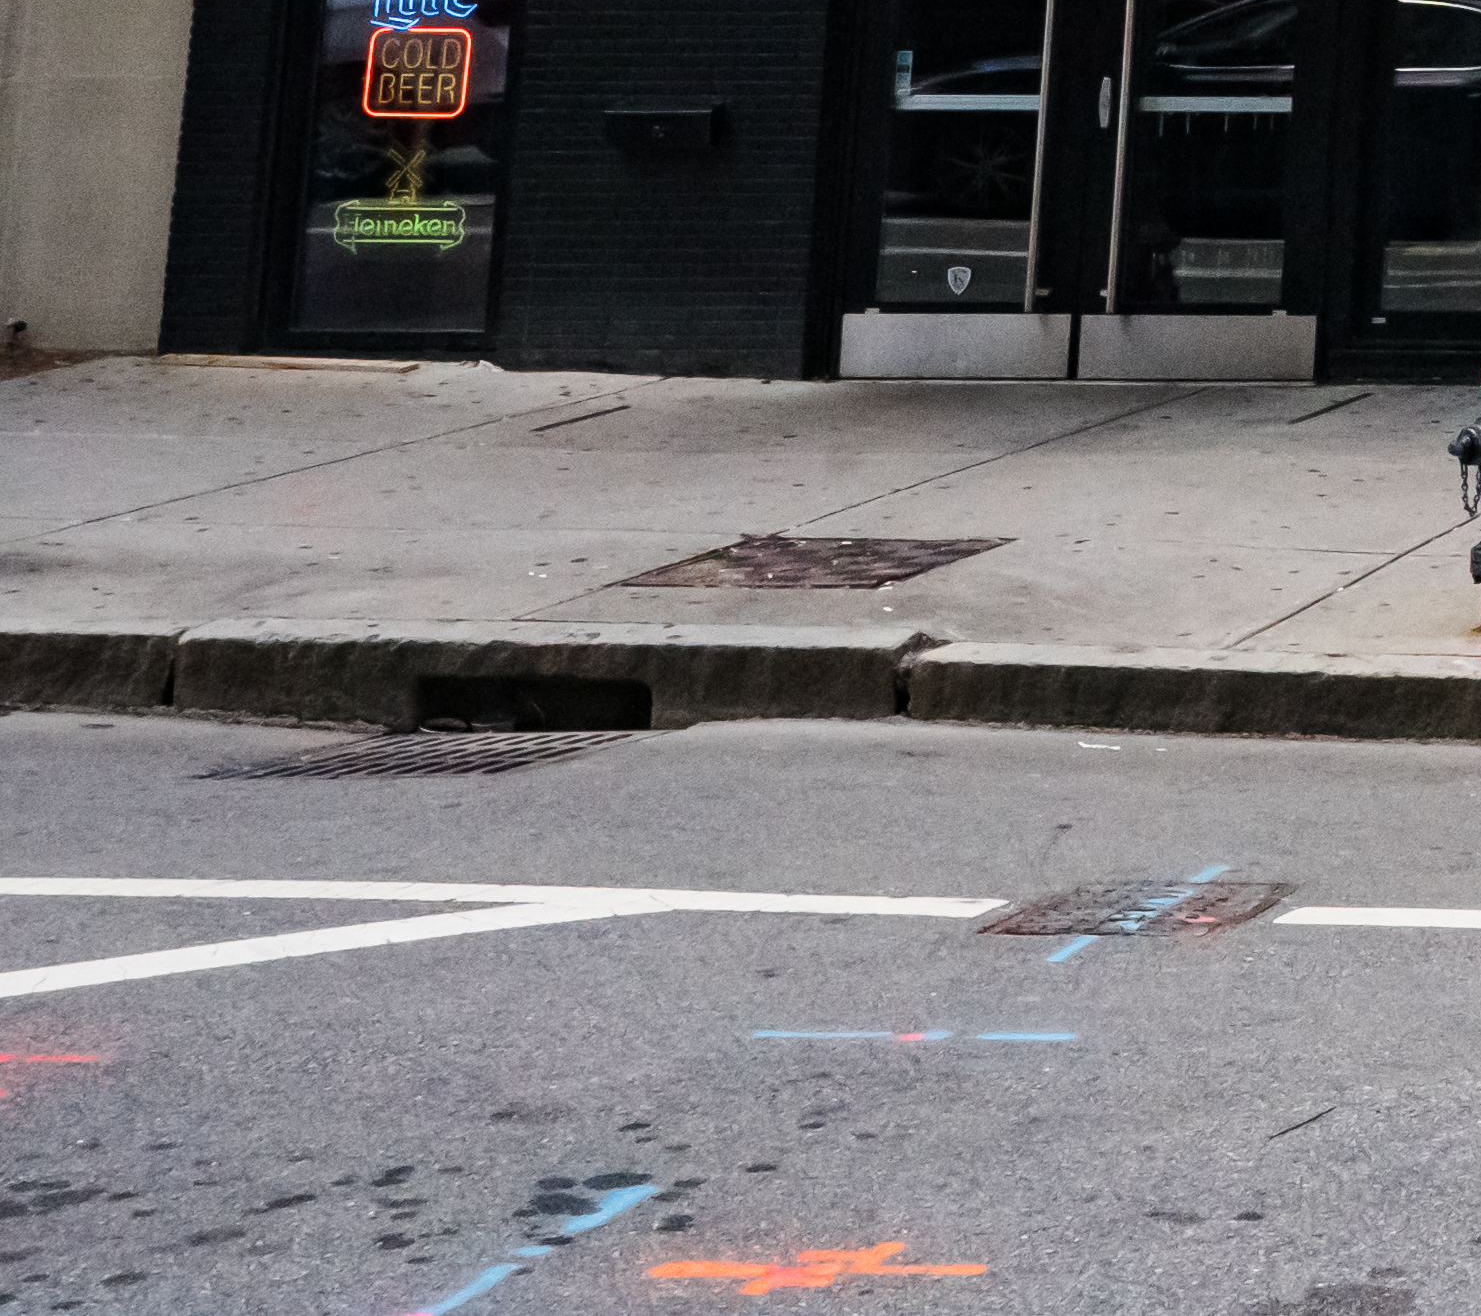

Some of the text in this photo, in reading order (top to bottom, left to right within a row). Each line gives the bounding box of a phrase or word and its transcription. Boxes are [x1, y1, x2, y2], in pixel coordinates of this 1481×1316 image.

[381, 38, 462, 69] COLD
[379, 73, 456, 105] BEER
[343, 213, 458, 237] Heineken
